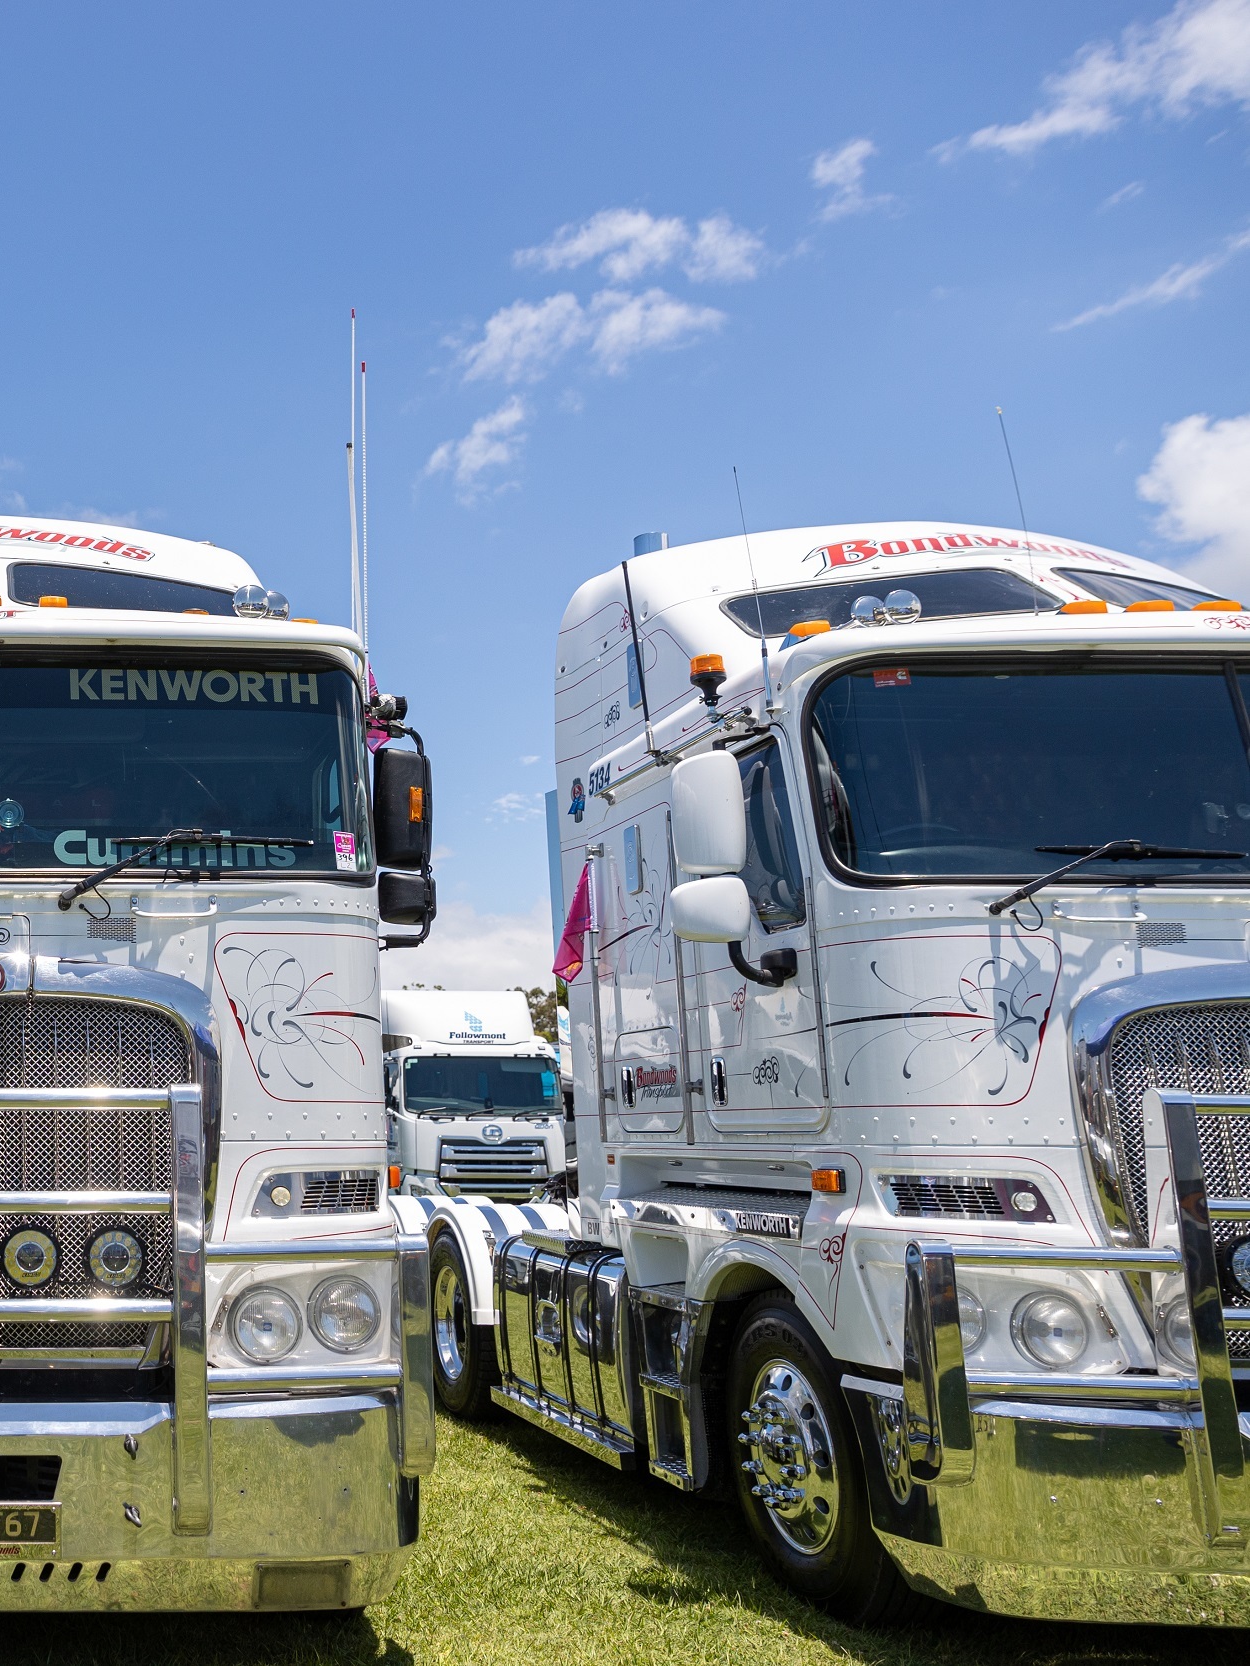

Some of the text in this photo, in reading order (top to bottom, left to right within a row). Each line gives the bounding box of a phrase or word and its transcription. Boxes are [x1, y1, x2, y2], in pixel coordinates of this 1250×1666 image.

[69, 668, 319, 705] KENWORTH
[589, 762, 611, 796] 5134
[449, 1031, 507, 1040] Followmont
[635, 1064, 678, 1087] Bondwoods
[735, 1213, 787, 1234] KENWORTH
